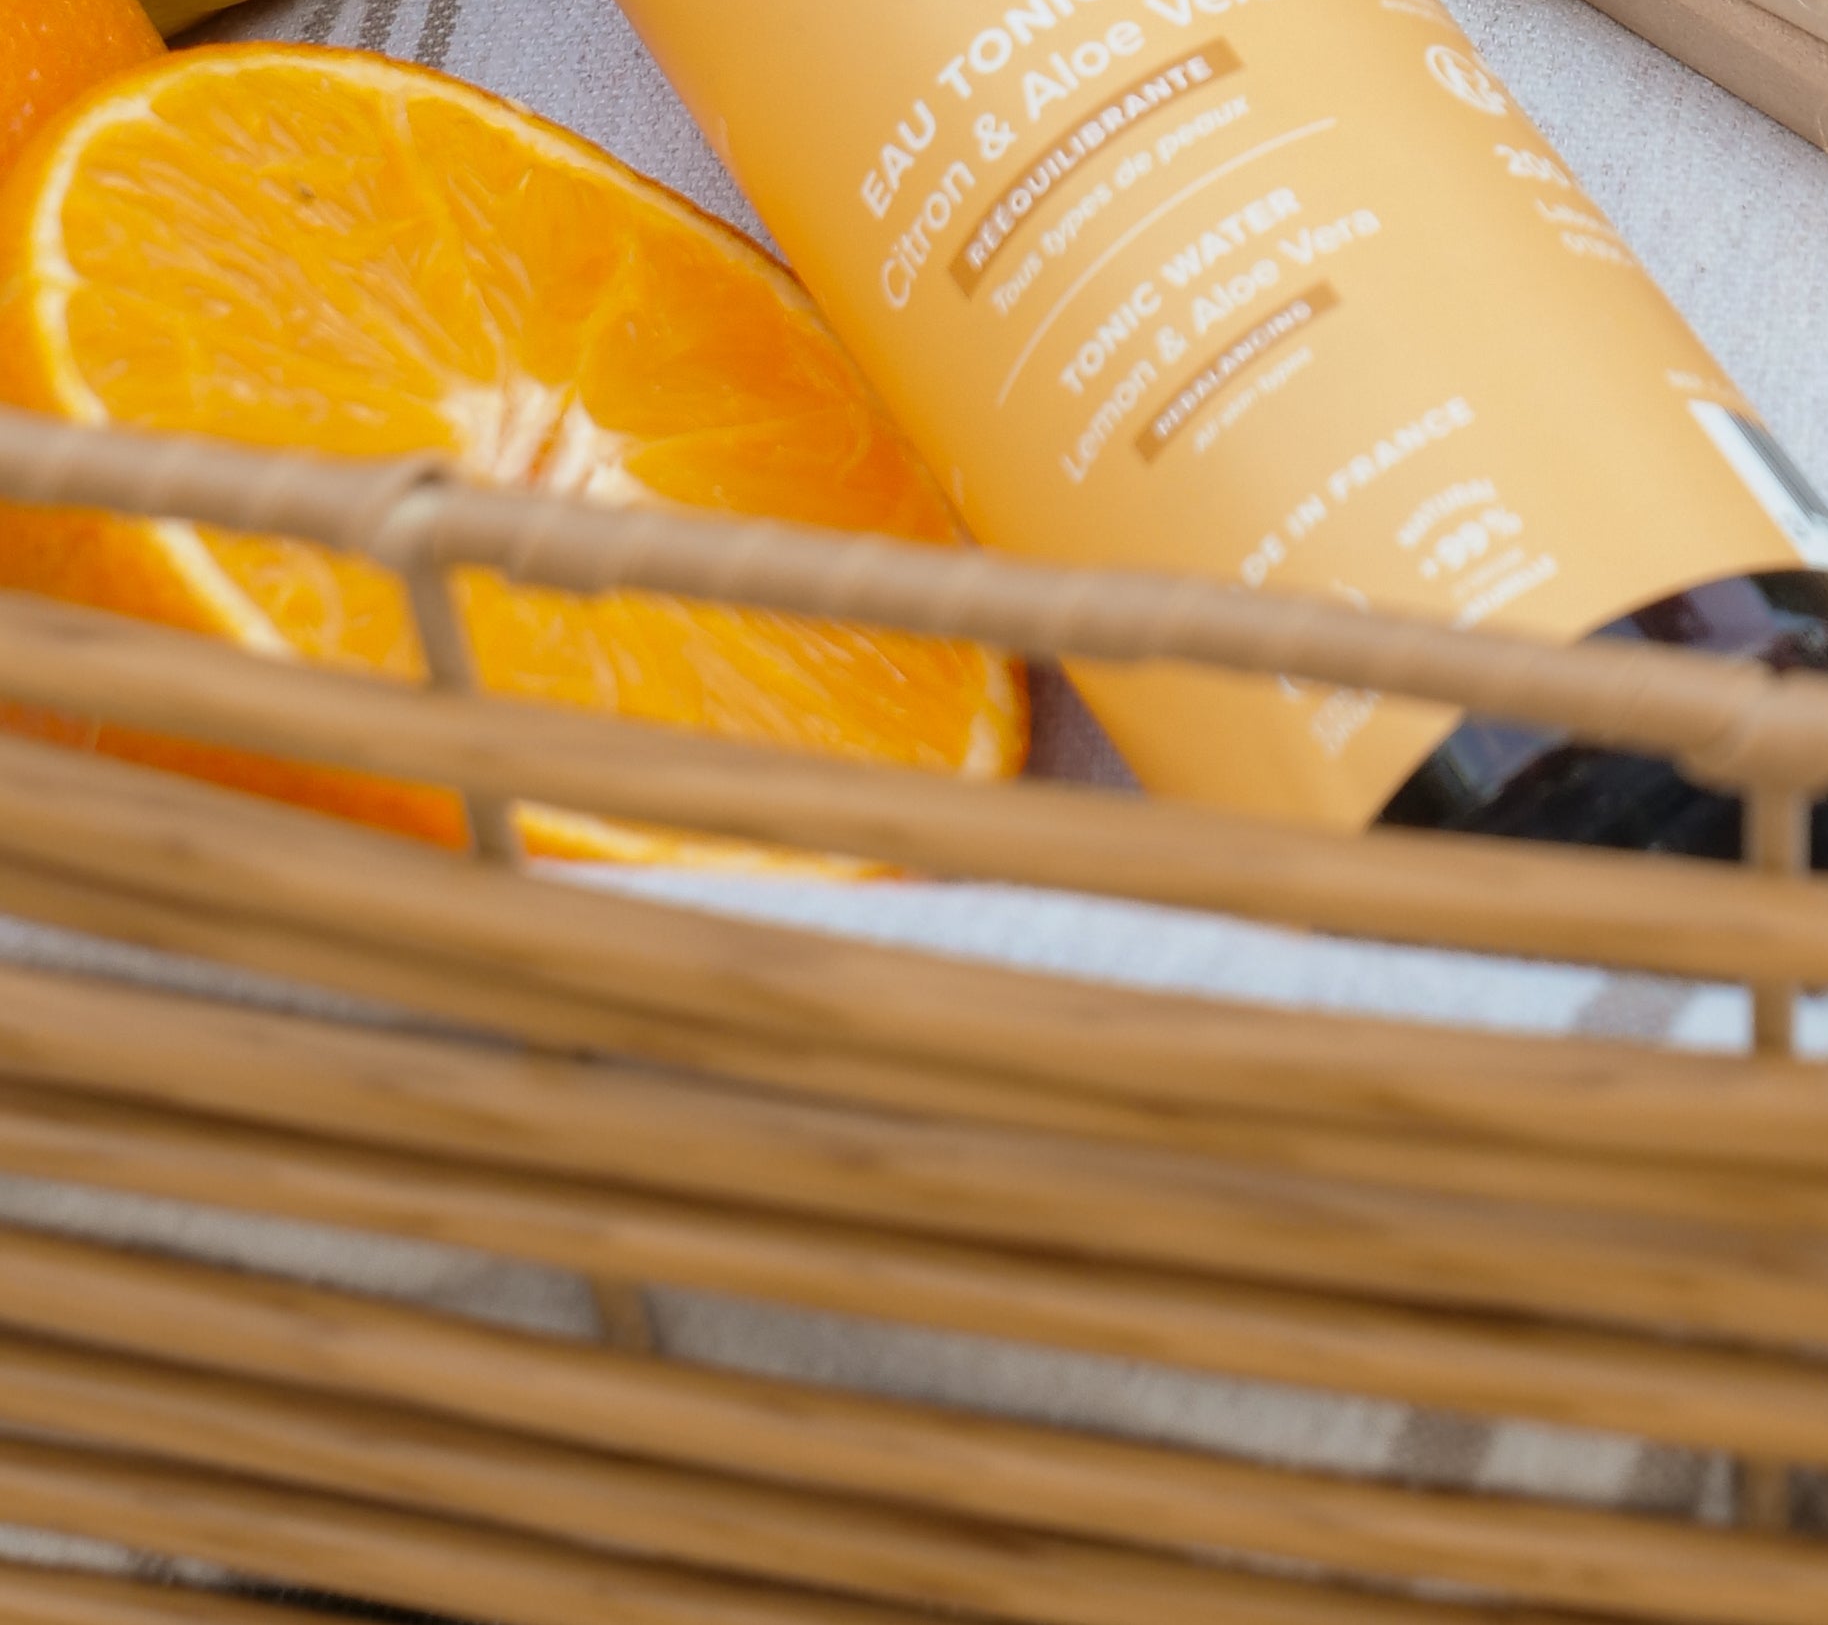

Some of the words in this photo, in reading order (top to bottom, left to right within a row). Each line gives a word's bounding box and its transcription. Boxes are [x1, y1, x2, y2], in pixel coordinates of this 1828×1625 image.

[860, 99, 937, 219] EAU
[880, 160, 977, 309] Citron
[973, 112, 1018, 161] &
[1021, 20, 1144, 121] Aloe
[990, 252, 1043, 316] Tous
[1040, 182, 1112, 260] types
[1114, 149, 1153, 189] de
[1156, 95, 1250, 164] peaux
[1059, 281, 1162, 396] TONIC
[1160, 186, 1302, 288] WATER
[1060, 360, 1158, 485] Lemon
[1153, 326, 1188, 365] &
[1190, 258, 1281, 336] Aloe
[1277, 208, 1382, 265] Vera
[1285, 494, 1327, 540] IN
[1328, 396, 1474, 501] FRANCE
